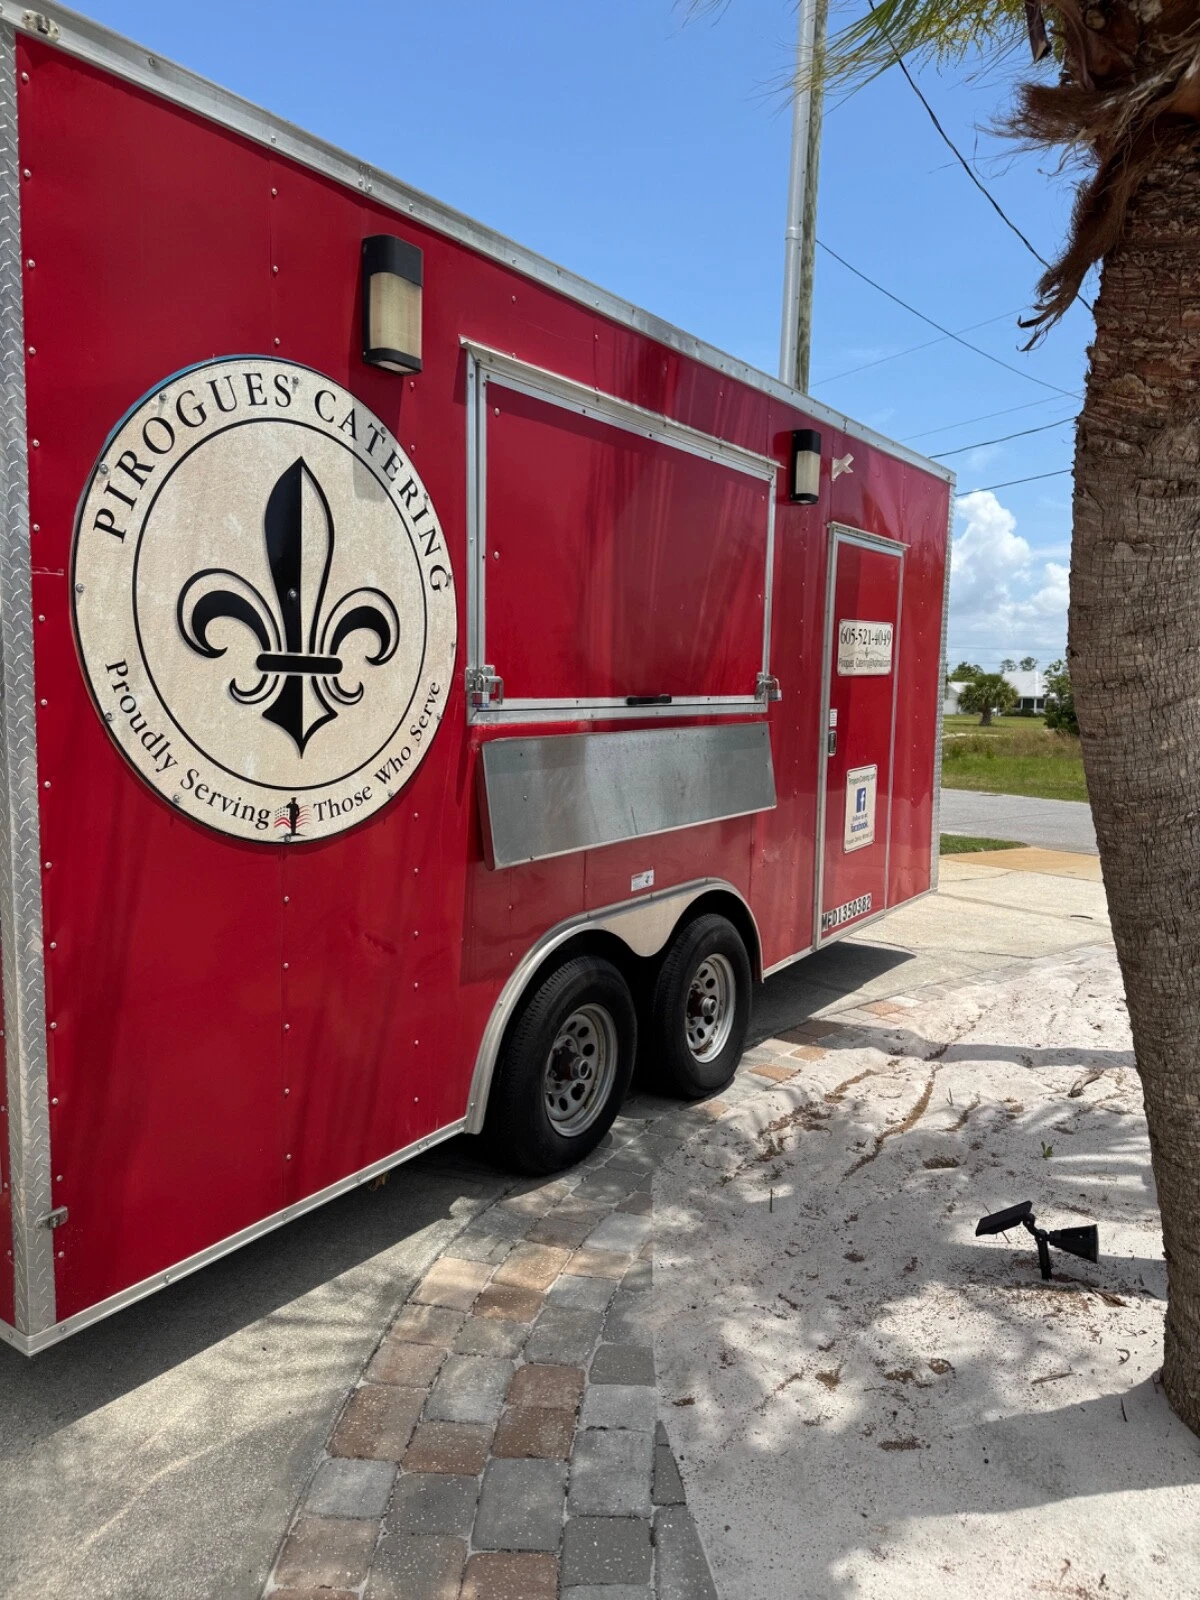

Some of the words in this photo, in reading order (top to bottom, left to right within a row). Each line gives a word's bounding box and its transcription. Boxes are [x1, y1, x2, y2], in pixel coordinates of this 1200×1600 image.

[93, 372, 291, 544] PIROGUES
[314, 389, 451, 593] CATERING
[105, 658, 178, 773] Proudly
[180, 768, 271, 830] Serving
[313, 786, 373, 822] Those
[373, 746, 411, 785] Who
[410, 682, 440, 742] Serve
